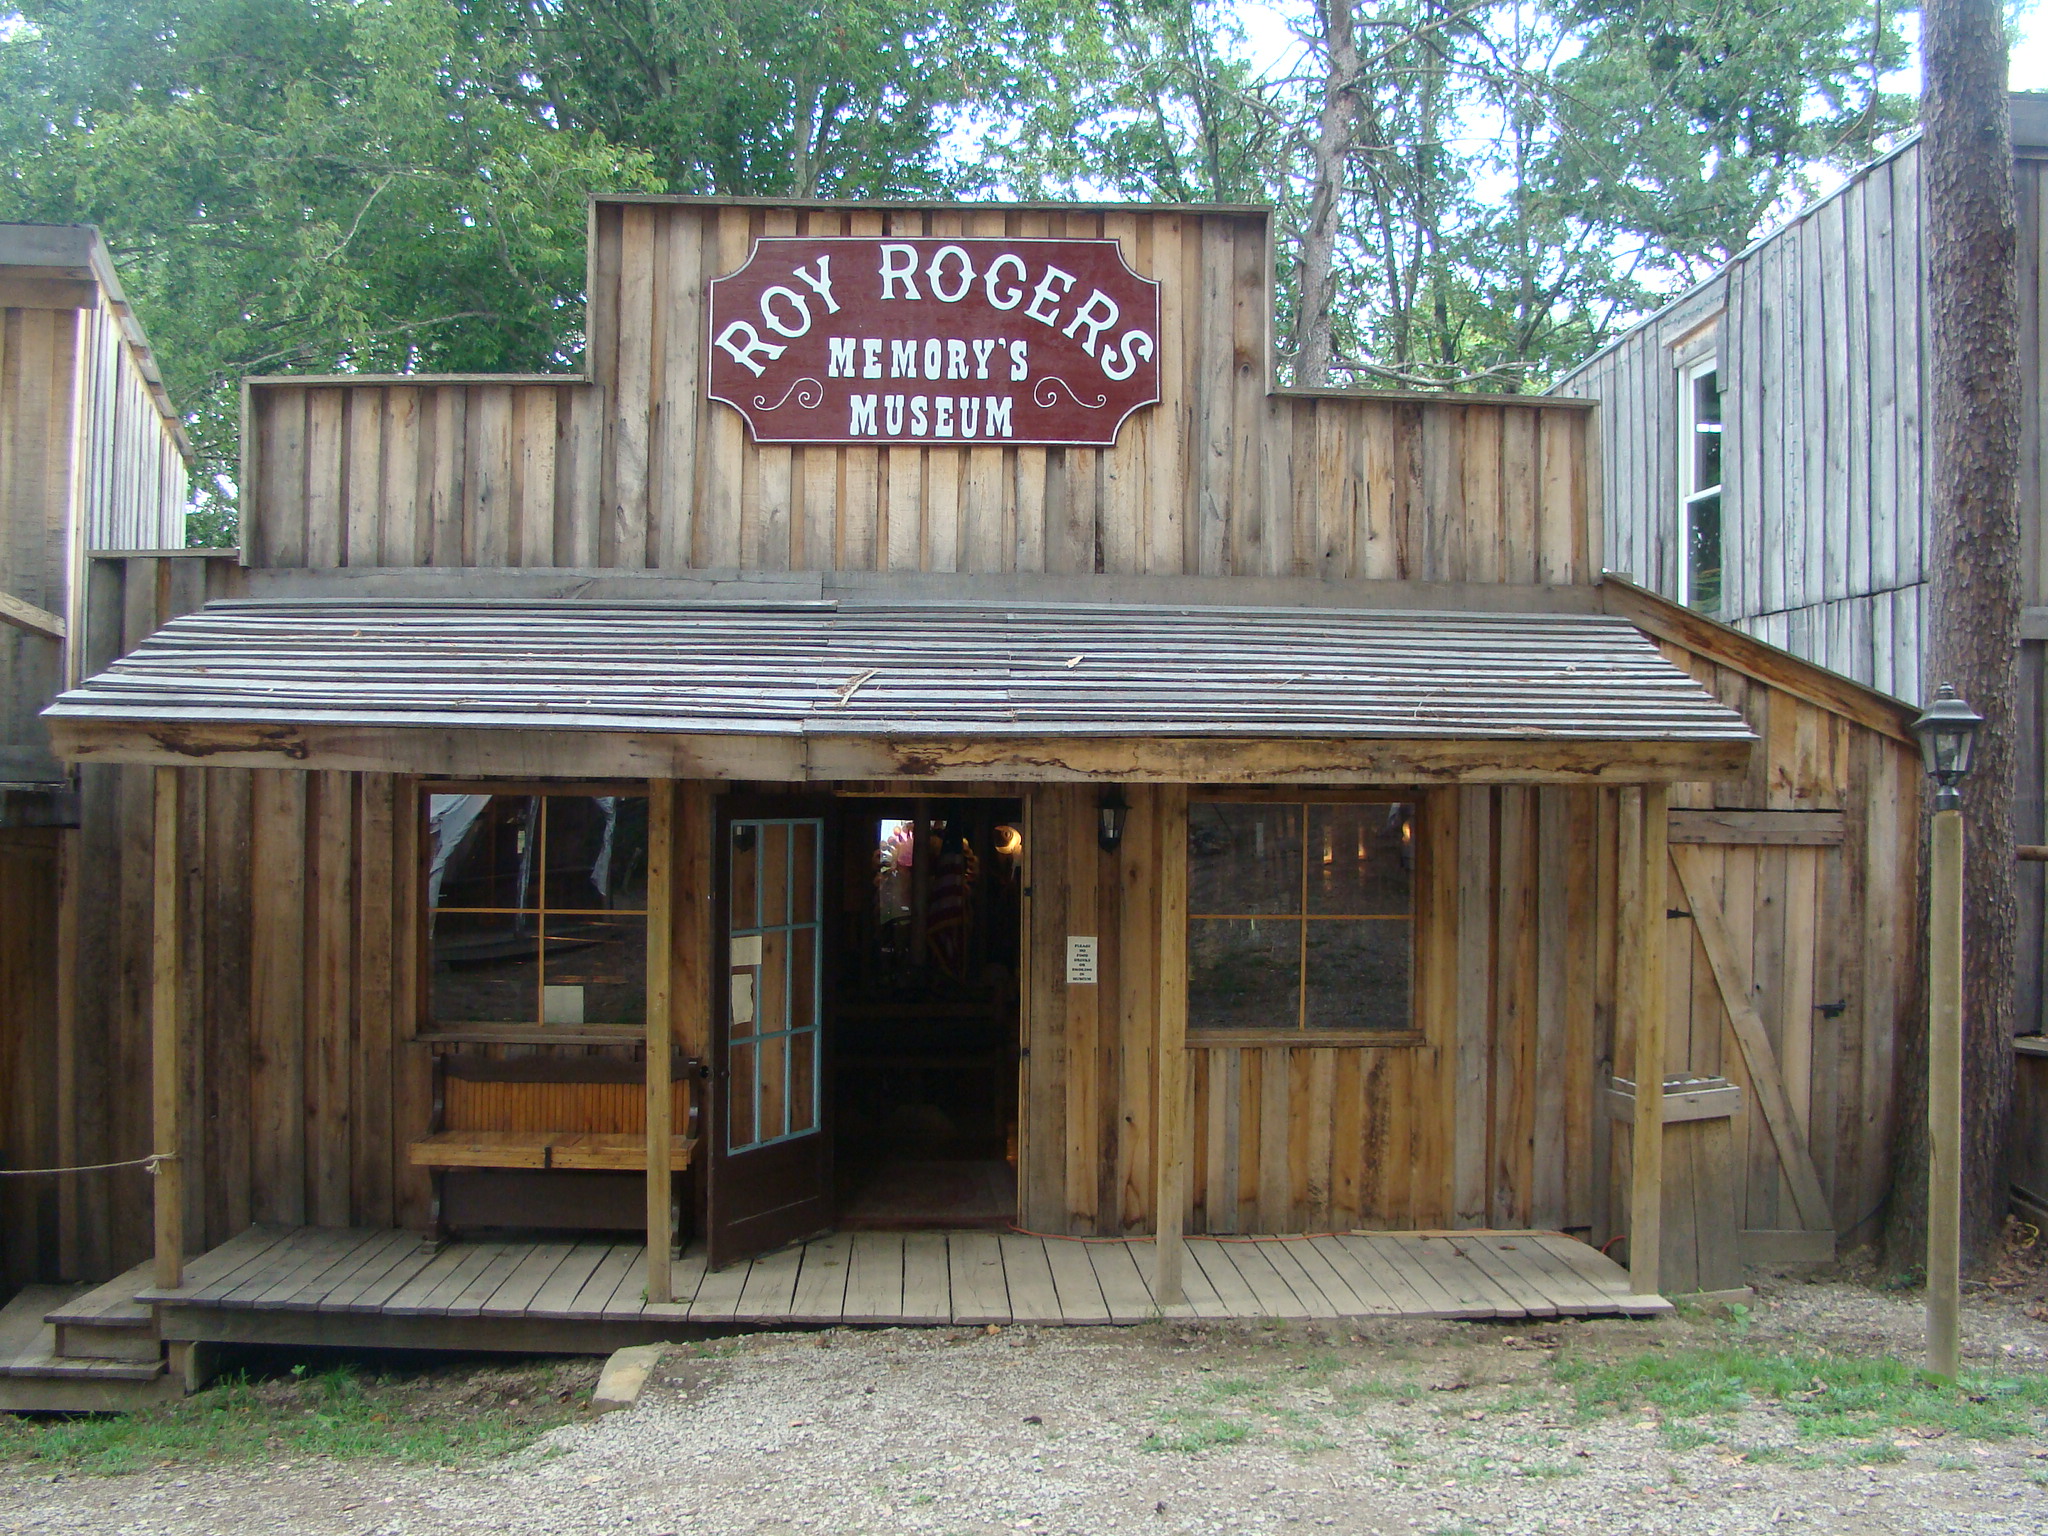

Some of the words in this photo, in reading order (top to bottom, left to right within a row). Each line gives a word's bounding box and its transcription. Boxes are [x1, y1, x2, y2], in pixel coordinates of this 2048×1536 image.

[714, 254, 841, 379] ROY
[878, 243, 1154, 381] ROGERS
[828, 337, 1028, 382] MEMORY'S
[849, 394, 1013, 438] MUSEUM
